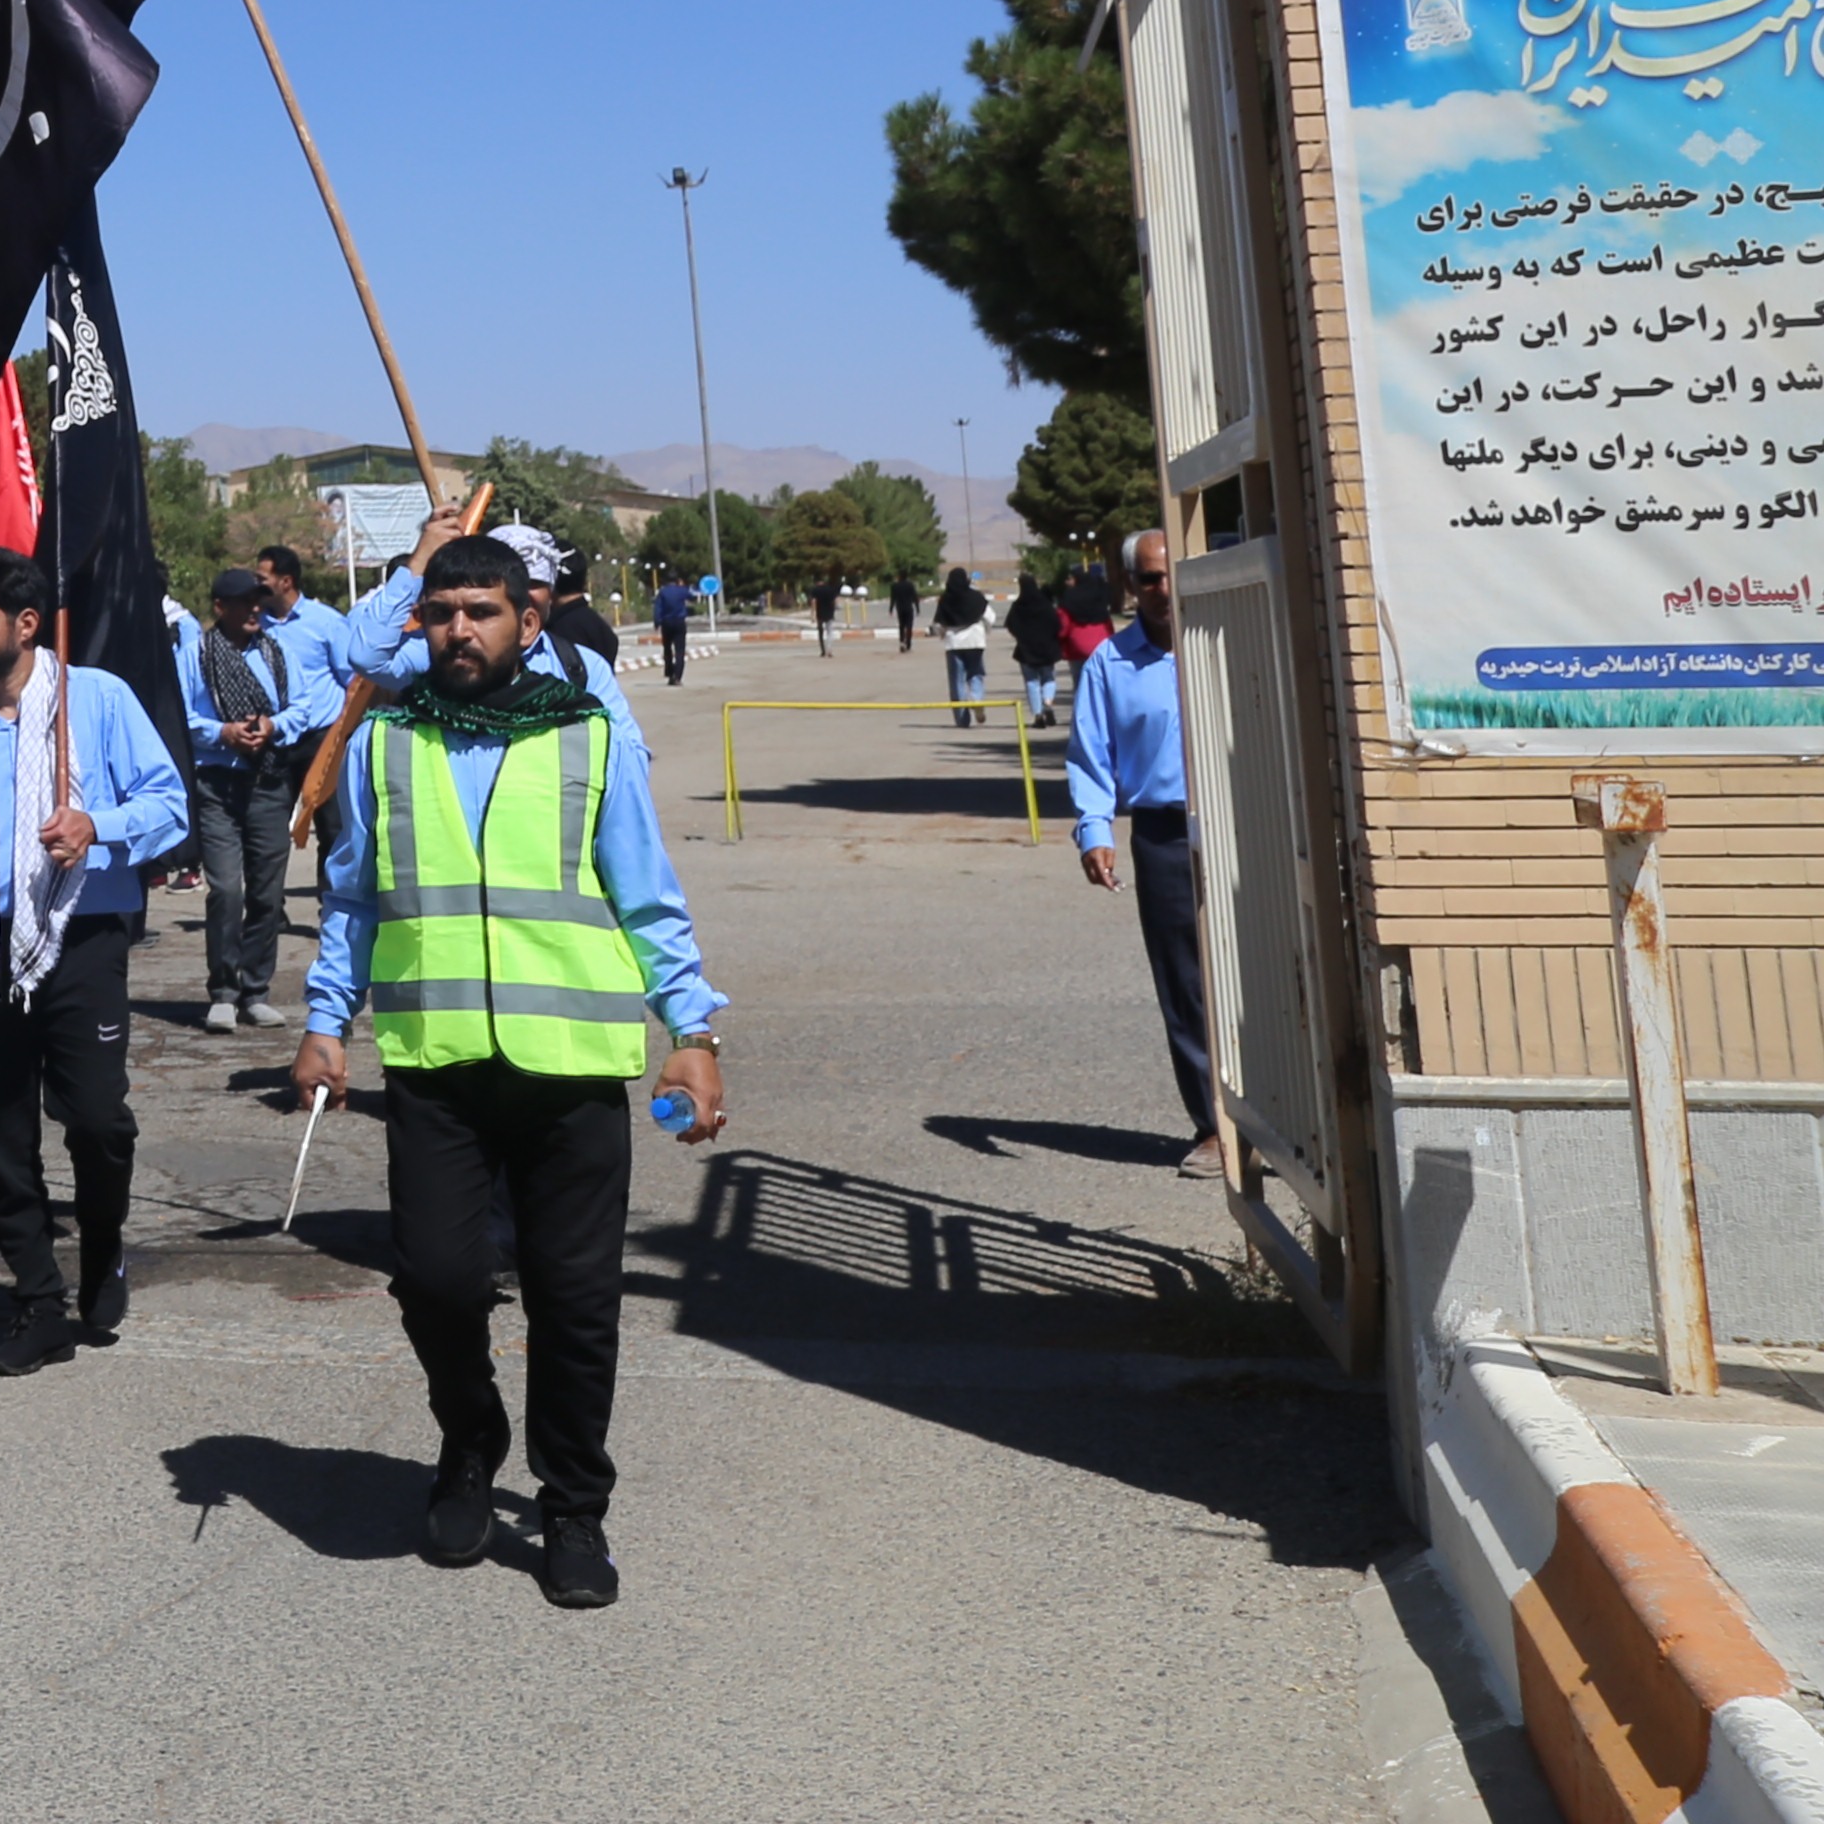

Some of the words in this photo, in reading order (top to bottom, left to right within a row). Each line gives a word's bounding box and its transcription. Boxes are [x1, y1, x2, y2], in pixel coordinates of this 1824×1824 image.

[1416, 194, 1484, 232] برای
[1490, 185, 1592, 229] فرصتی
[1599, 181, 1699, 218] حقیقت
[1708, 181, 1745, 216] در
[1422, 256, 1503, 291] وسیله
[1512, 259, 1541, 287] به
[1550, 249, 1585, 276] که
[1597, 244, 1663, 275] است
[1675, 237, 1786, 280] عظیمی
[1429, 314, 1504, 354] کشور
[1519, 311, 1568, 349] این
[1582, 314, 1618, 347] در
[1436, 376, 1483, 414] این
[1494, 381, 1530, 413] در
[1687, 365, 1737, 404] این
[1749, 376, 1767, 402] و
[1440, 437, 1504, 472] ملتها
[1515, 435, 1578, 474] دیگر
[1588, 433, 1655, 471] برای
[1760, 440, 1778, 464] و
[1510, 496, 1606, 534] خواهد
[1614, 493, 1726, 533] سرمشق
[1734, 505, 1751, 530] و
[1758, 488, 1819, 529] الگو
[1480, 659, 1539, 679] حیدریه
[1540, 656, 1581, 678] تربت
[1581, 653, 1640, 678] اسلامی
[1642, 652, 1679, 678] آزاد
[1679, 653, 1743, 673] دانشگاه
